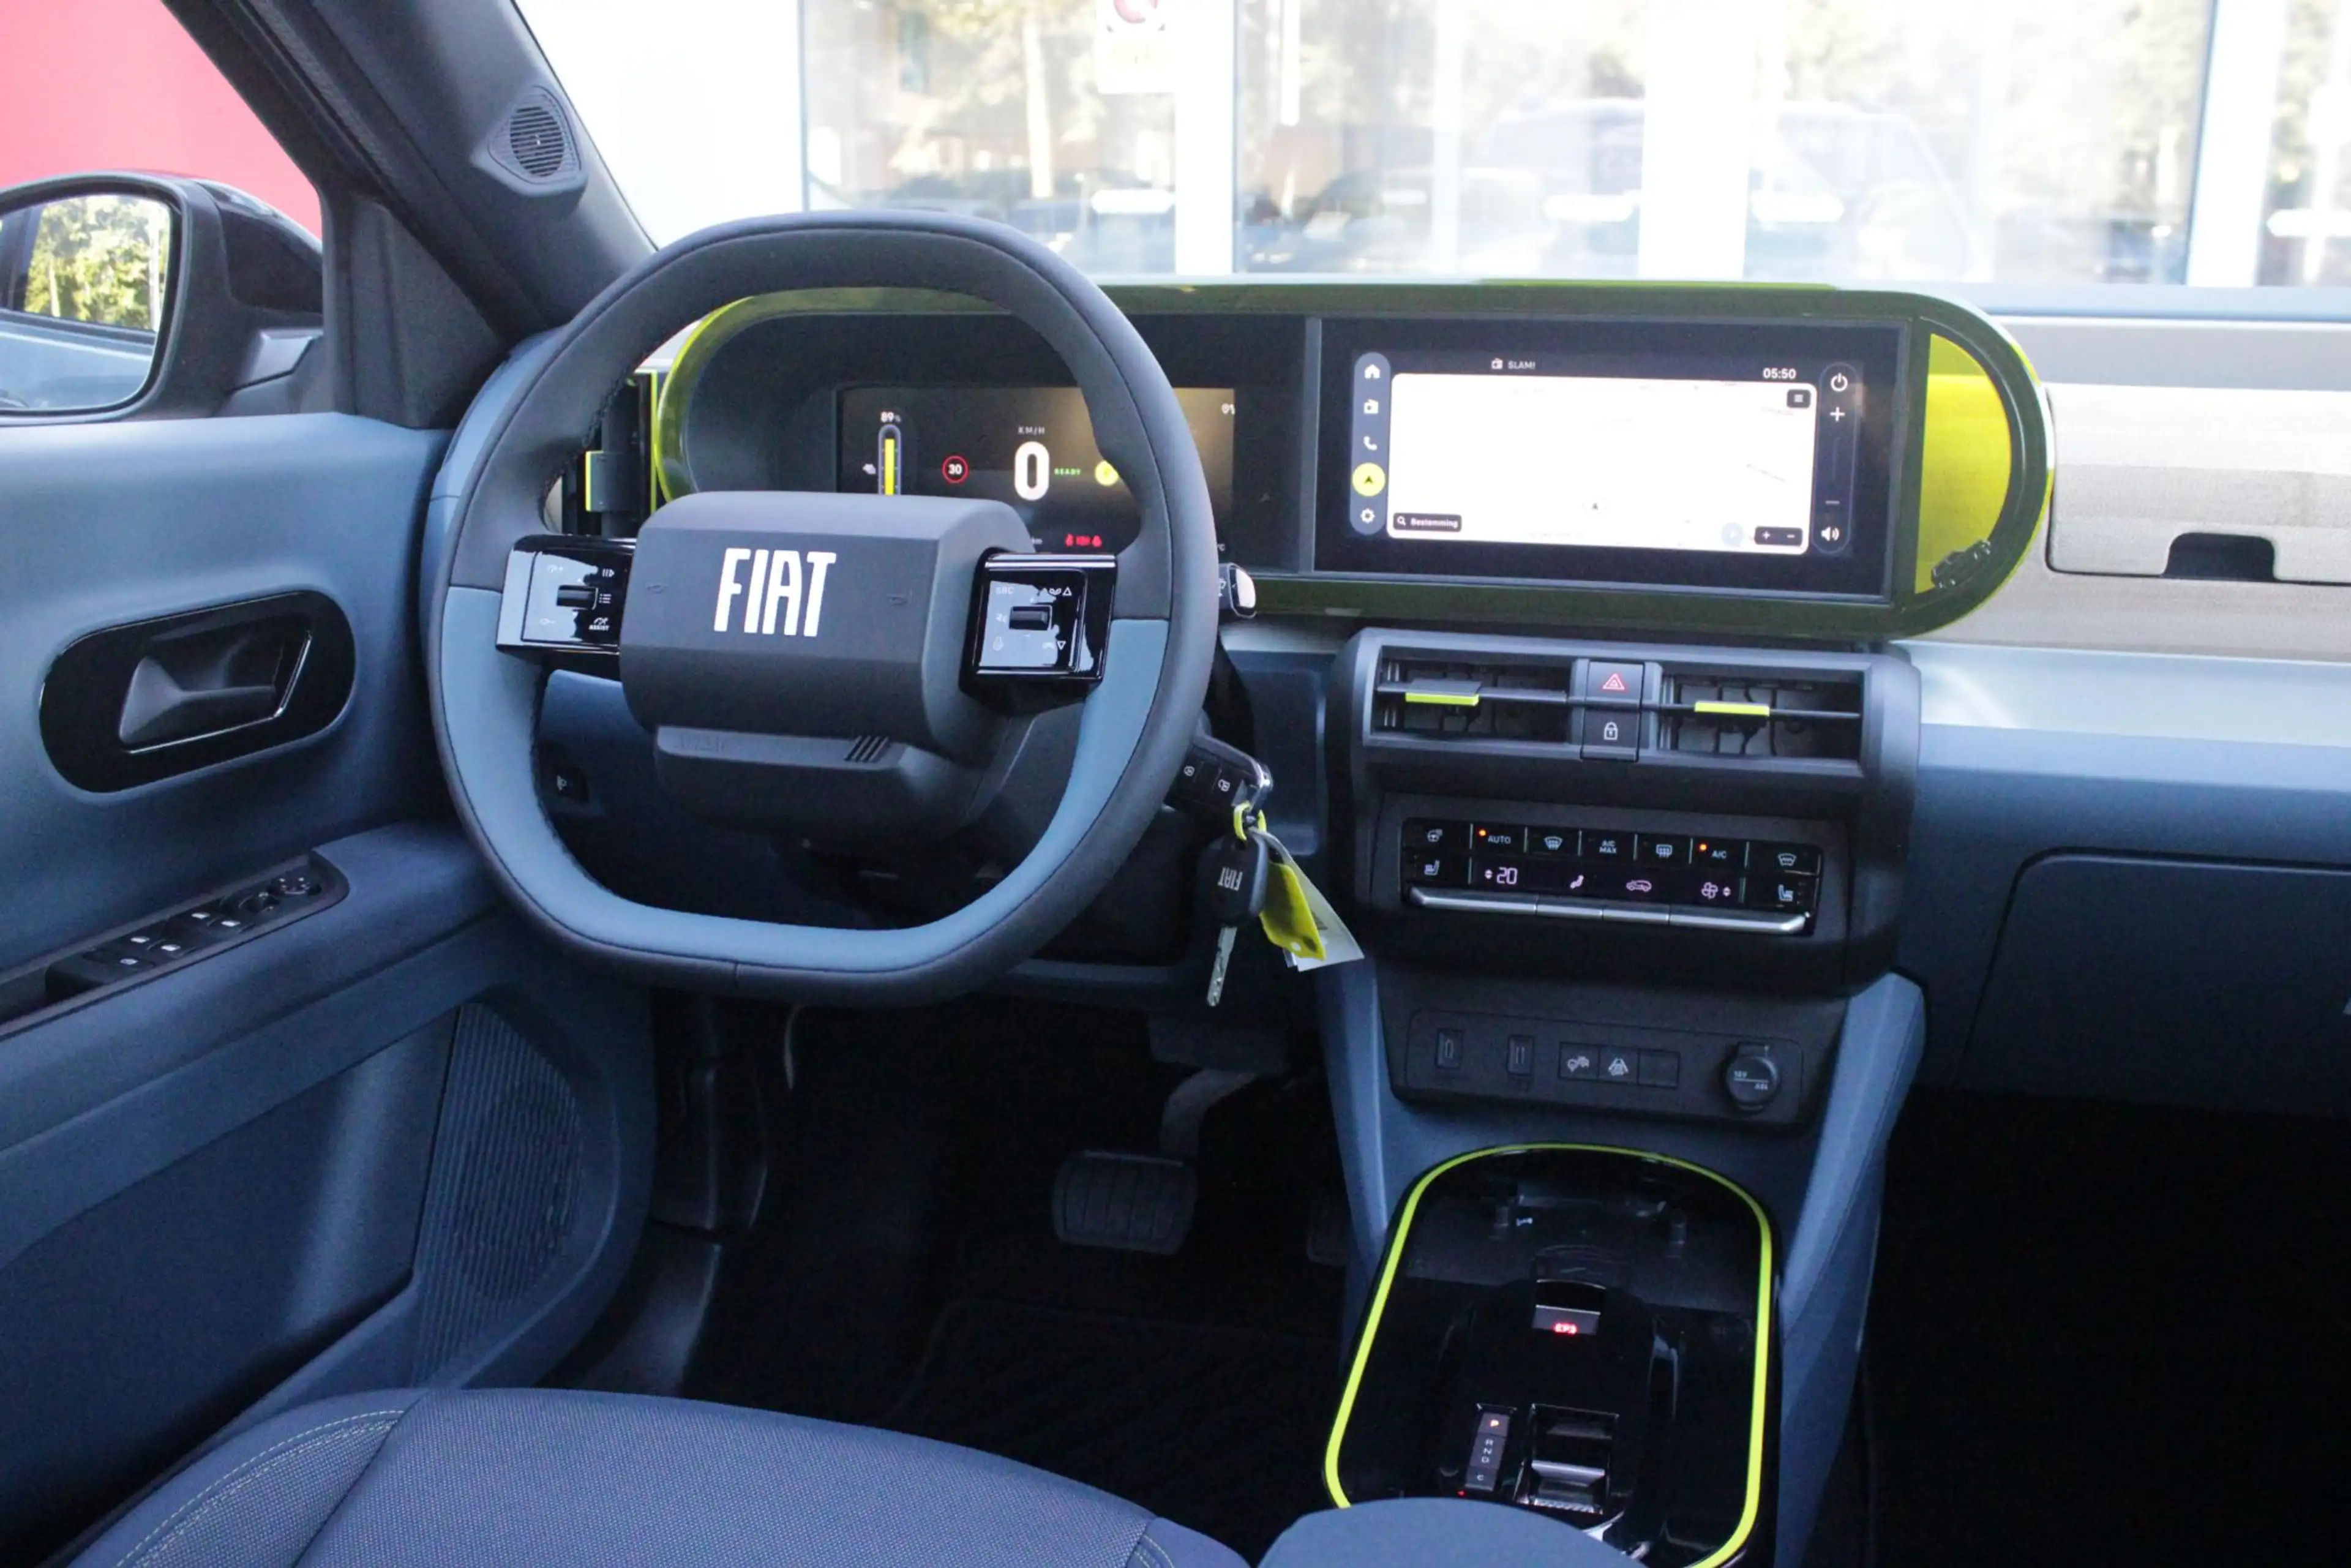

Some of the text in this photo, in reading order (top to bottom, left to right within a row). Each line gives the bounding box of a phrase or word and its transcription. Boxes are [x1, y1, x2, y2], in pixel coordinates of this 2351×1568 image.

[1763, 367, 1796, 379] 05:50
[1018, 426, 1045, 435] KM/H
[948, 463, 962, 475] 30
[1015, 441, 1049, 501] 0
[714, 548, 837, 637] FIAT
[996, 586, 1014, 595] SRC
[1488, 835, 1512, 844] AUTO
[1712, 850, 1727, 859] A/C
[1217, 867, 1243, 891] FIAT
[1497, 867, 1518, 885] 20
